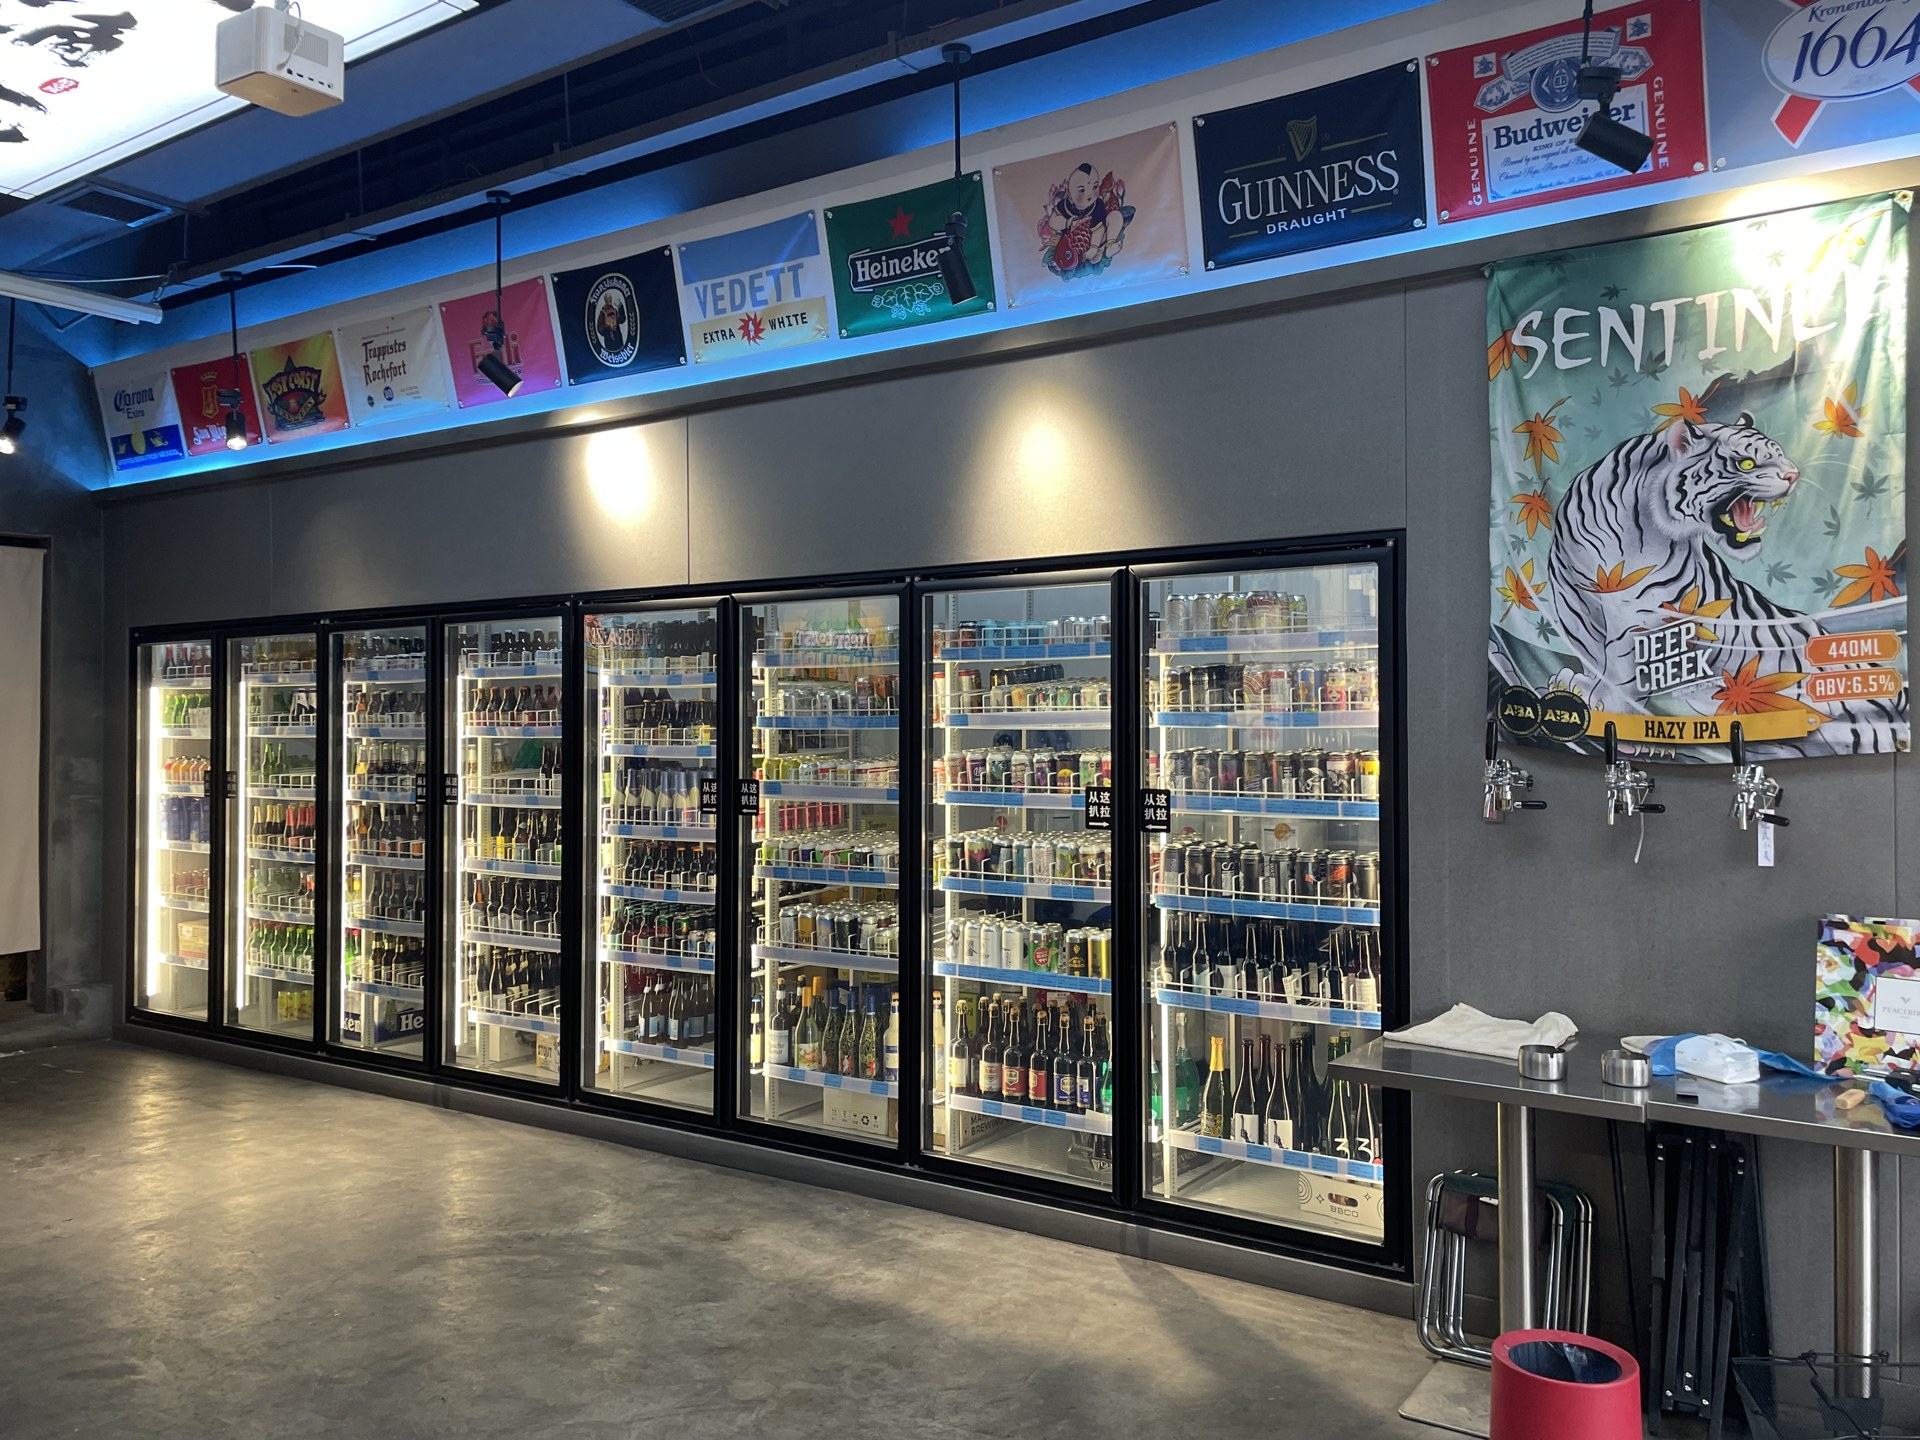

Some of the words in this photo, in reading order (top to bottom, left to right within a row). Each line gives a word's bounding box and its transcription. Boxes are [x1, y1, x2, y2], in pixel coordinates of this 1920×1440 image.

[1792, 6, 1920, 83] 1664
[1493, 102, 1635, 149] Budweier
[1652, 75, 1670, 169] GENUINE
[1466, 117, 1483, 206] GENUINE
[1218, 149, 1399, 226] GUINNESS
[1266, 207, 1348, 234] DRAUGHT
[694, 262, 804, 319] VEDETT
[703, 327, 736, 345] EXTRA
[768, 312, 808, 331] WHITE
[362, 338, 407, 364] Trappistes
[288, 369, 319, 392] COAST
[363, 361, 407, 386] Rochefort
[114, 387, 155, 412] Corona
[1633, 622, 1696, 663] DEEP
[1828, 637, 1882, 659] 440ML
[1635, 648, 1714, 692] CREEK
[1815, 672, 1895, 696] ABV:6.5%
[1644, 720, 1687, 739] HAZY
[1693, 720, 1720, 739] IPA
[740, 783, 758, 793] 从这
[1088, 791, 1111, 803] 从这
[1144, 793, 1167, 806] 从这
[1088, 805, 1111, 818] 扒拉
[1144, 808, 1167, 820] 扒拉
